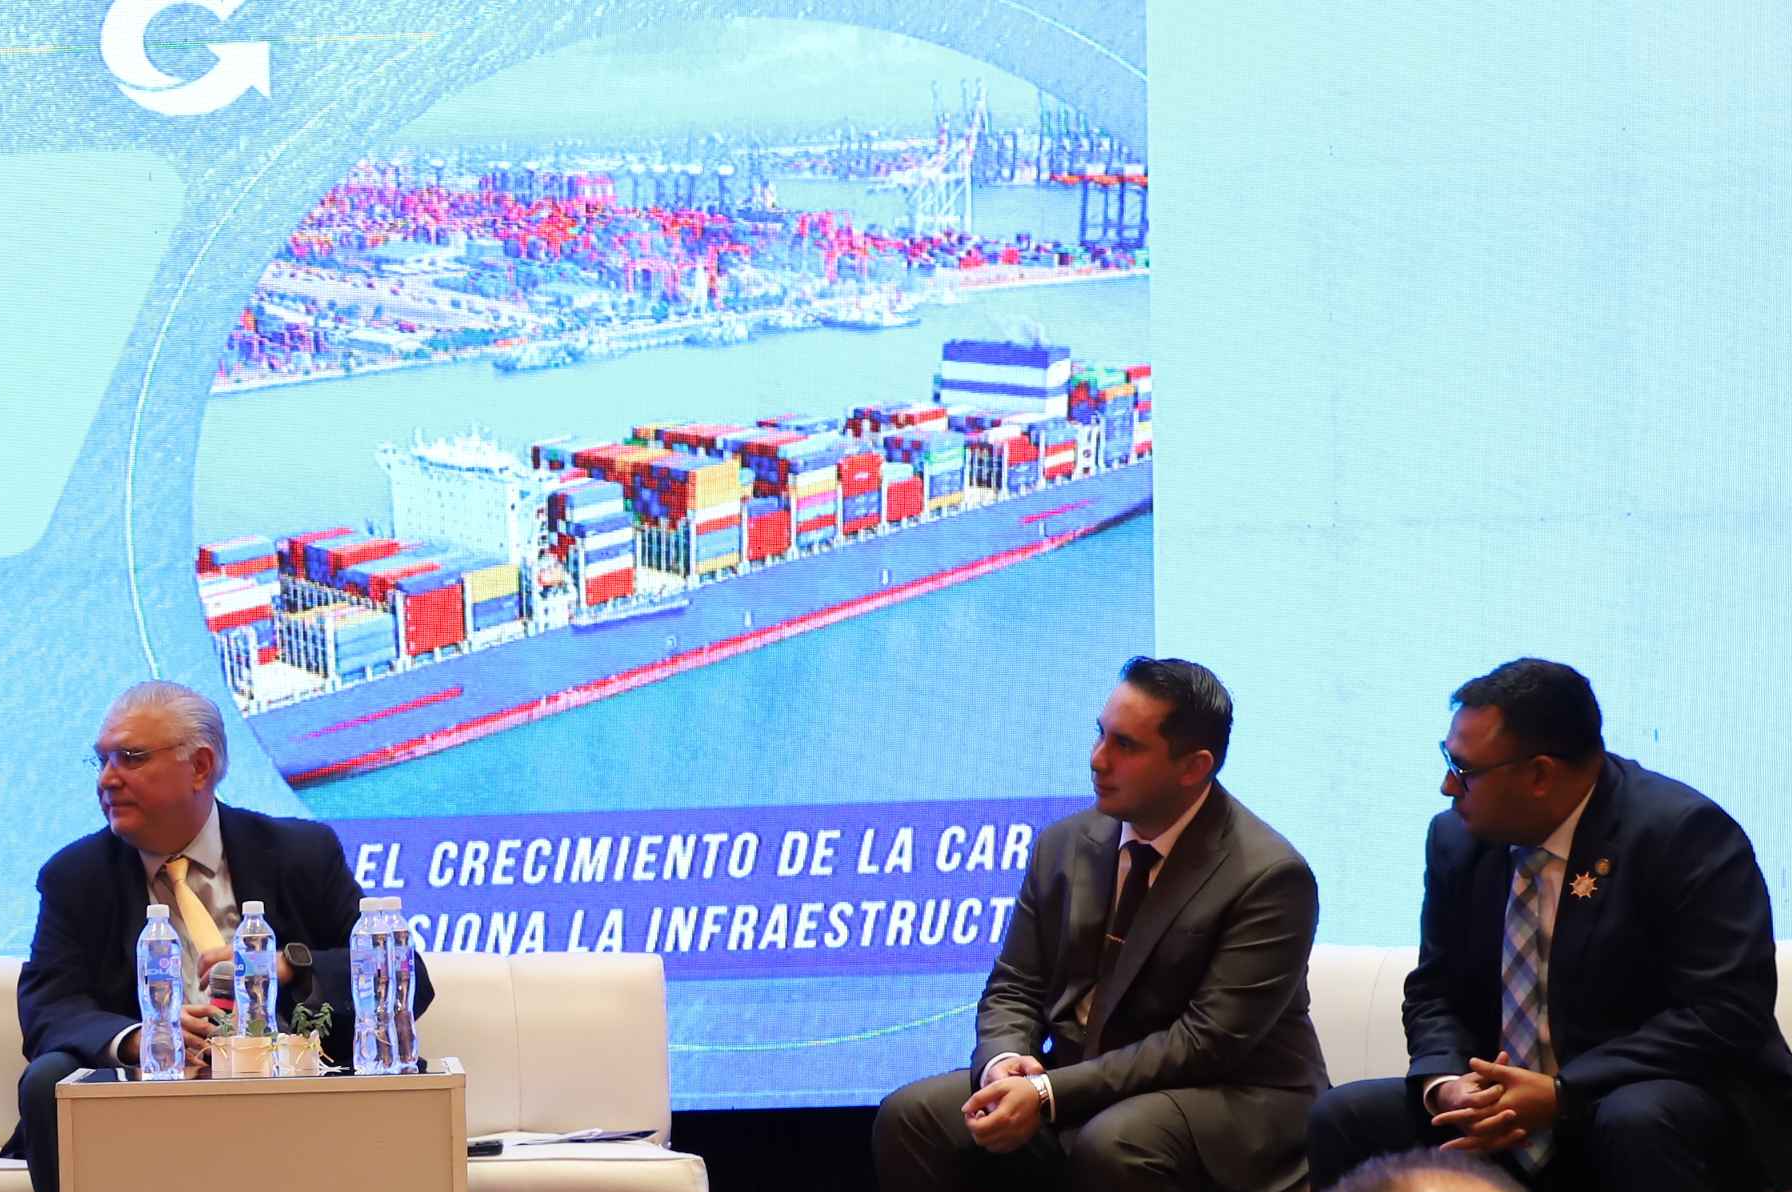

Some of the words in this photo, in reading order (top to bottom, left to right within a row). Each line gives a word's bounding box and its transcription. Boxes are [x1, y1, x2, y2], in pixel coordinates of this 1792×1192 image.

[354, 843, 407, 889] EL
[427, 832, 760, 888] CRECIMIENTO
[777, 829, 842, 877] DE
[857, 827, 915, 875] LA
[935, 823, 1034, 873] CAR
[566, 908, 625, 952] LA
[644, 897, 1016, 953] INFRAESTRUCT
